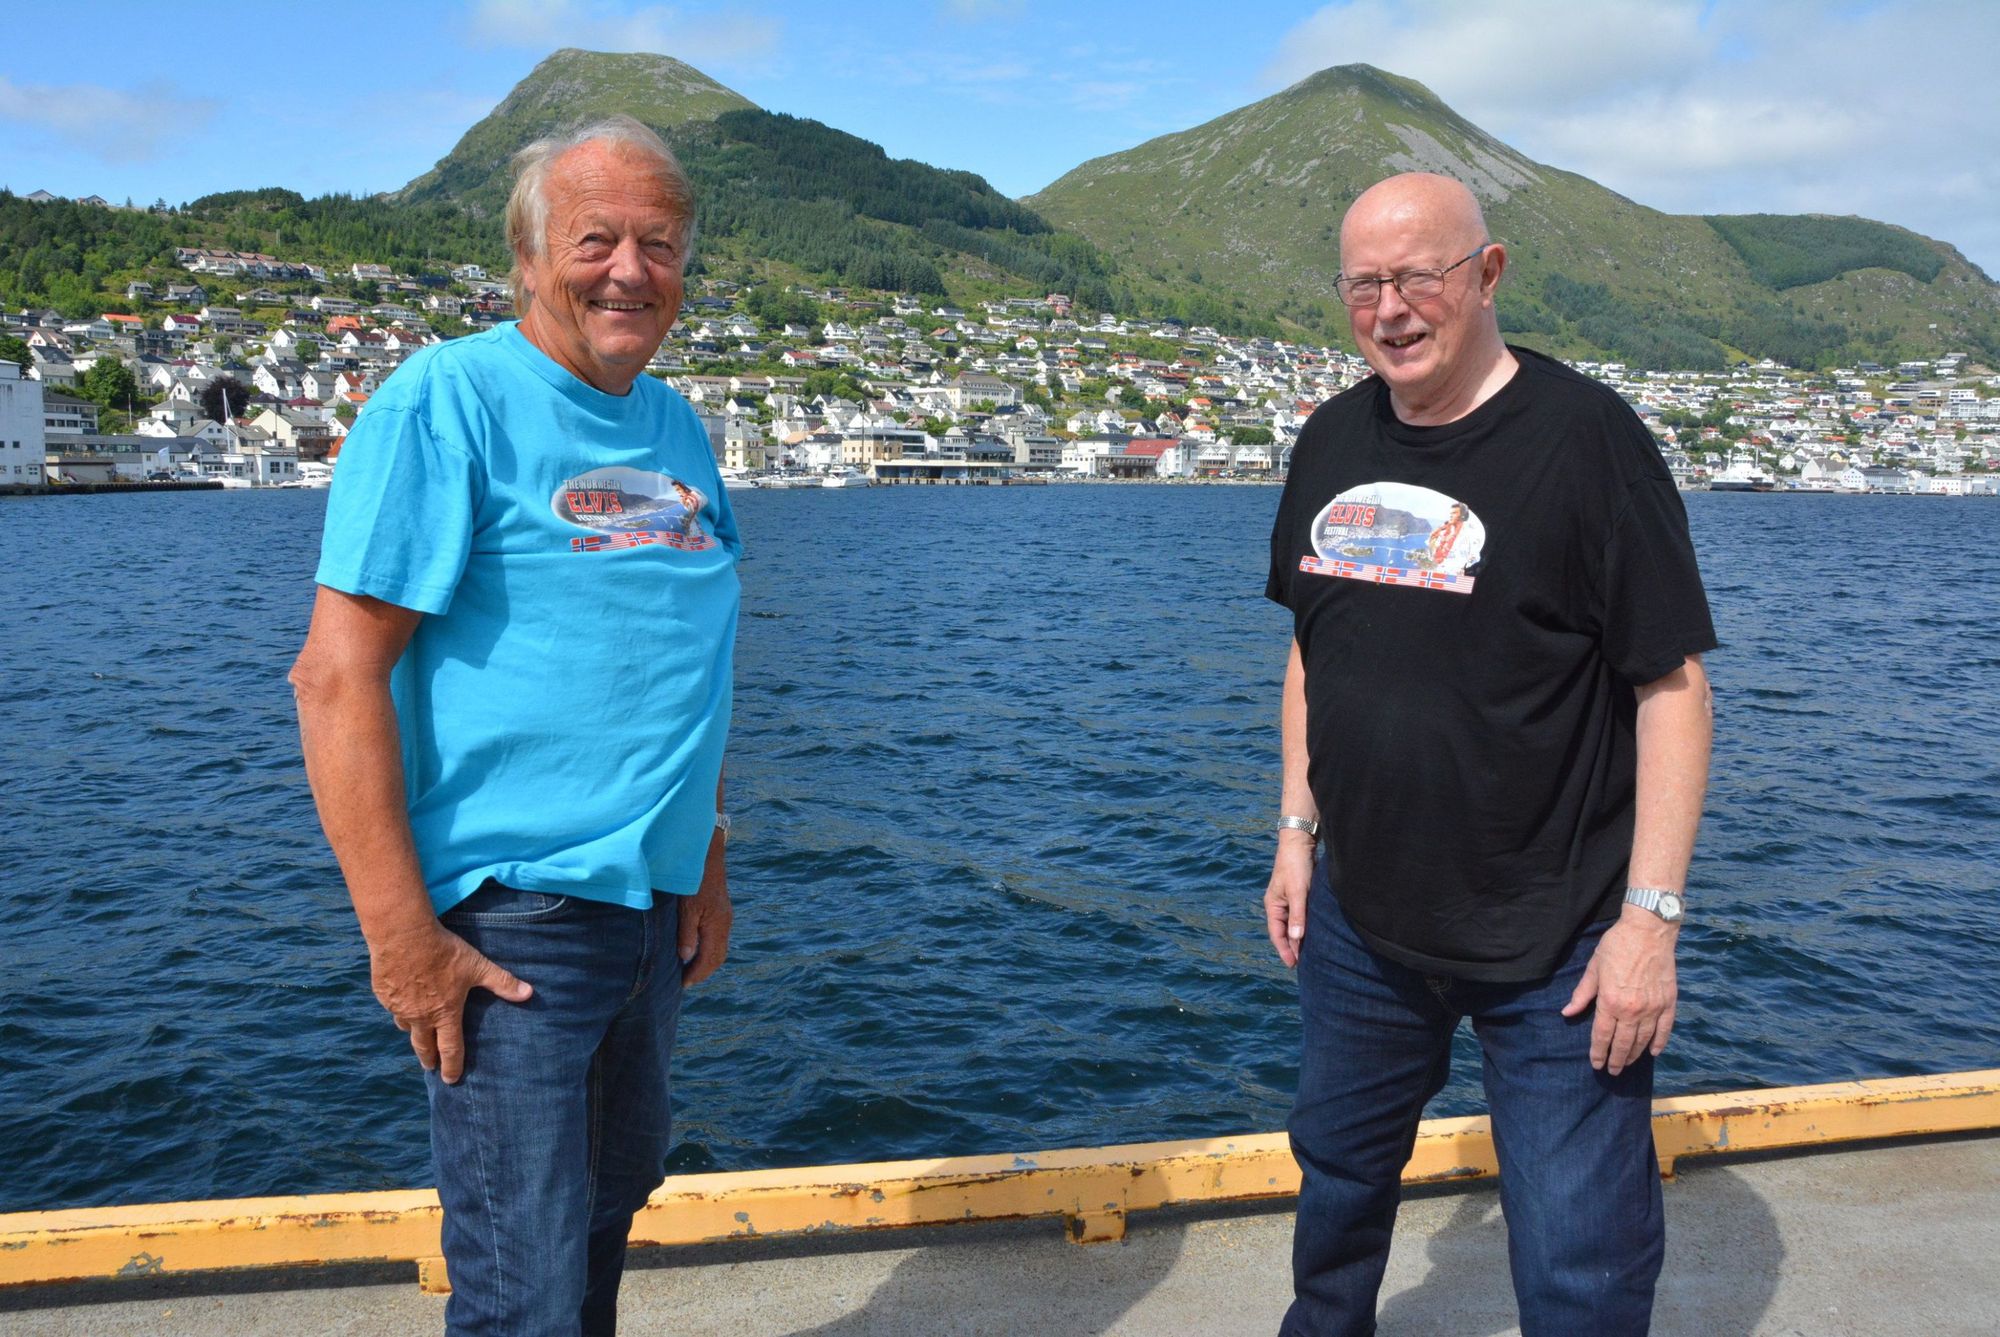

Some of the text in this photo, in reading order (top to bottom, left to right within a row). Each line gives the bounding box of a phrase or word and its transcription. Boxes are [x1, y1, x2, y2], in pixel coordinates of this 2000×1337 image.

[563, 480, 622, 490] THE NORWEGIAN
[565, 491, 622, 513] ELVIS
[1328, 504, 1376, 527] ELVIS
